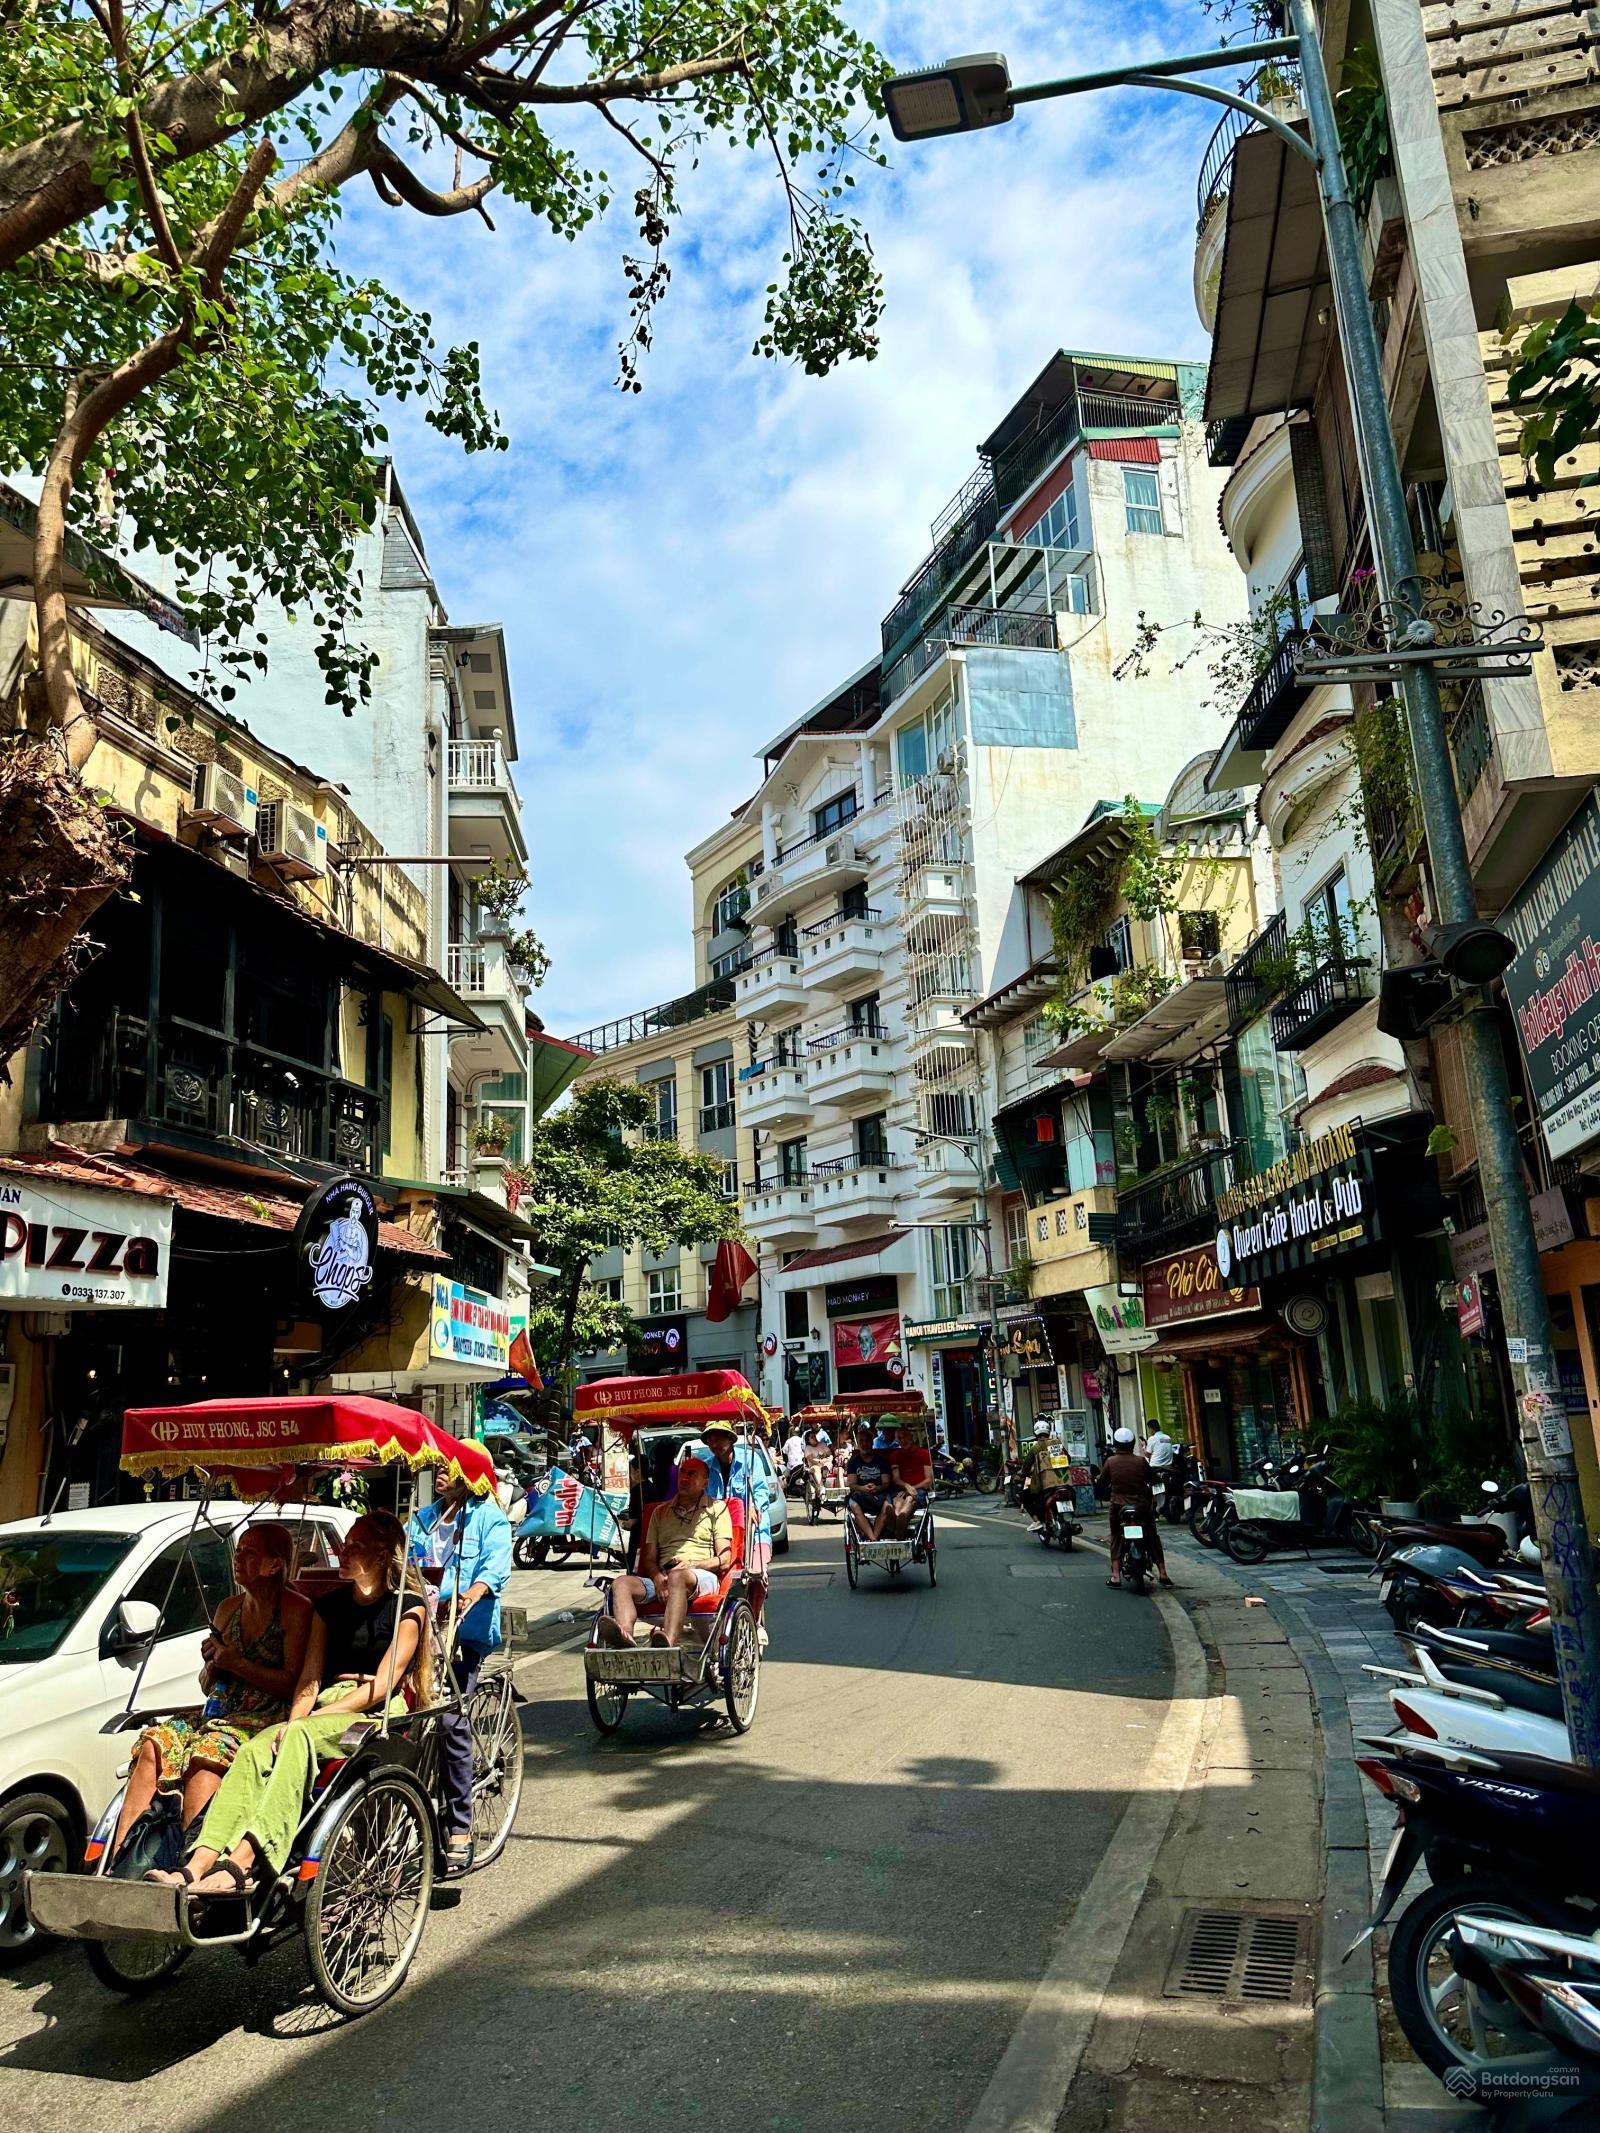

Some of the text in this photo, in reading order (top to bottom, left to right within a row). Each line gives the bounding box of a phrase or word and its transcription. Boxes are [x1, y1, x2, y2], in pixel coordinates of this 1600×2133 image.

[1551, 1028, 1589, 1075] BOOKING
[1233, 1221, 1262, 1262] Queen
[1262, 1205, 1288, 1249] Cafe
[1288, 1188, 1323, 1239] Hotel
[1324, 1200, 1334, 1225] &
[1332, 1171, 1362, 1221] Pub
[842, 1292, 870, 1303] MONKEY
[615, 1391, 631, 1401] HUY
[667, 1386, 682, 1396] JSC
[687, 1385, 698, 1396] 67
[182, 1422, 205, 1439] HUY
[256, 1420, 277, 1438] JSC
[280, 1420, 300, 1436] 54
[1456, 1776, 1539, 1800] VISION
